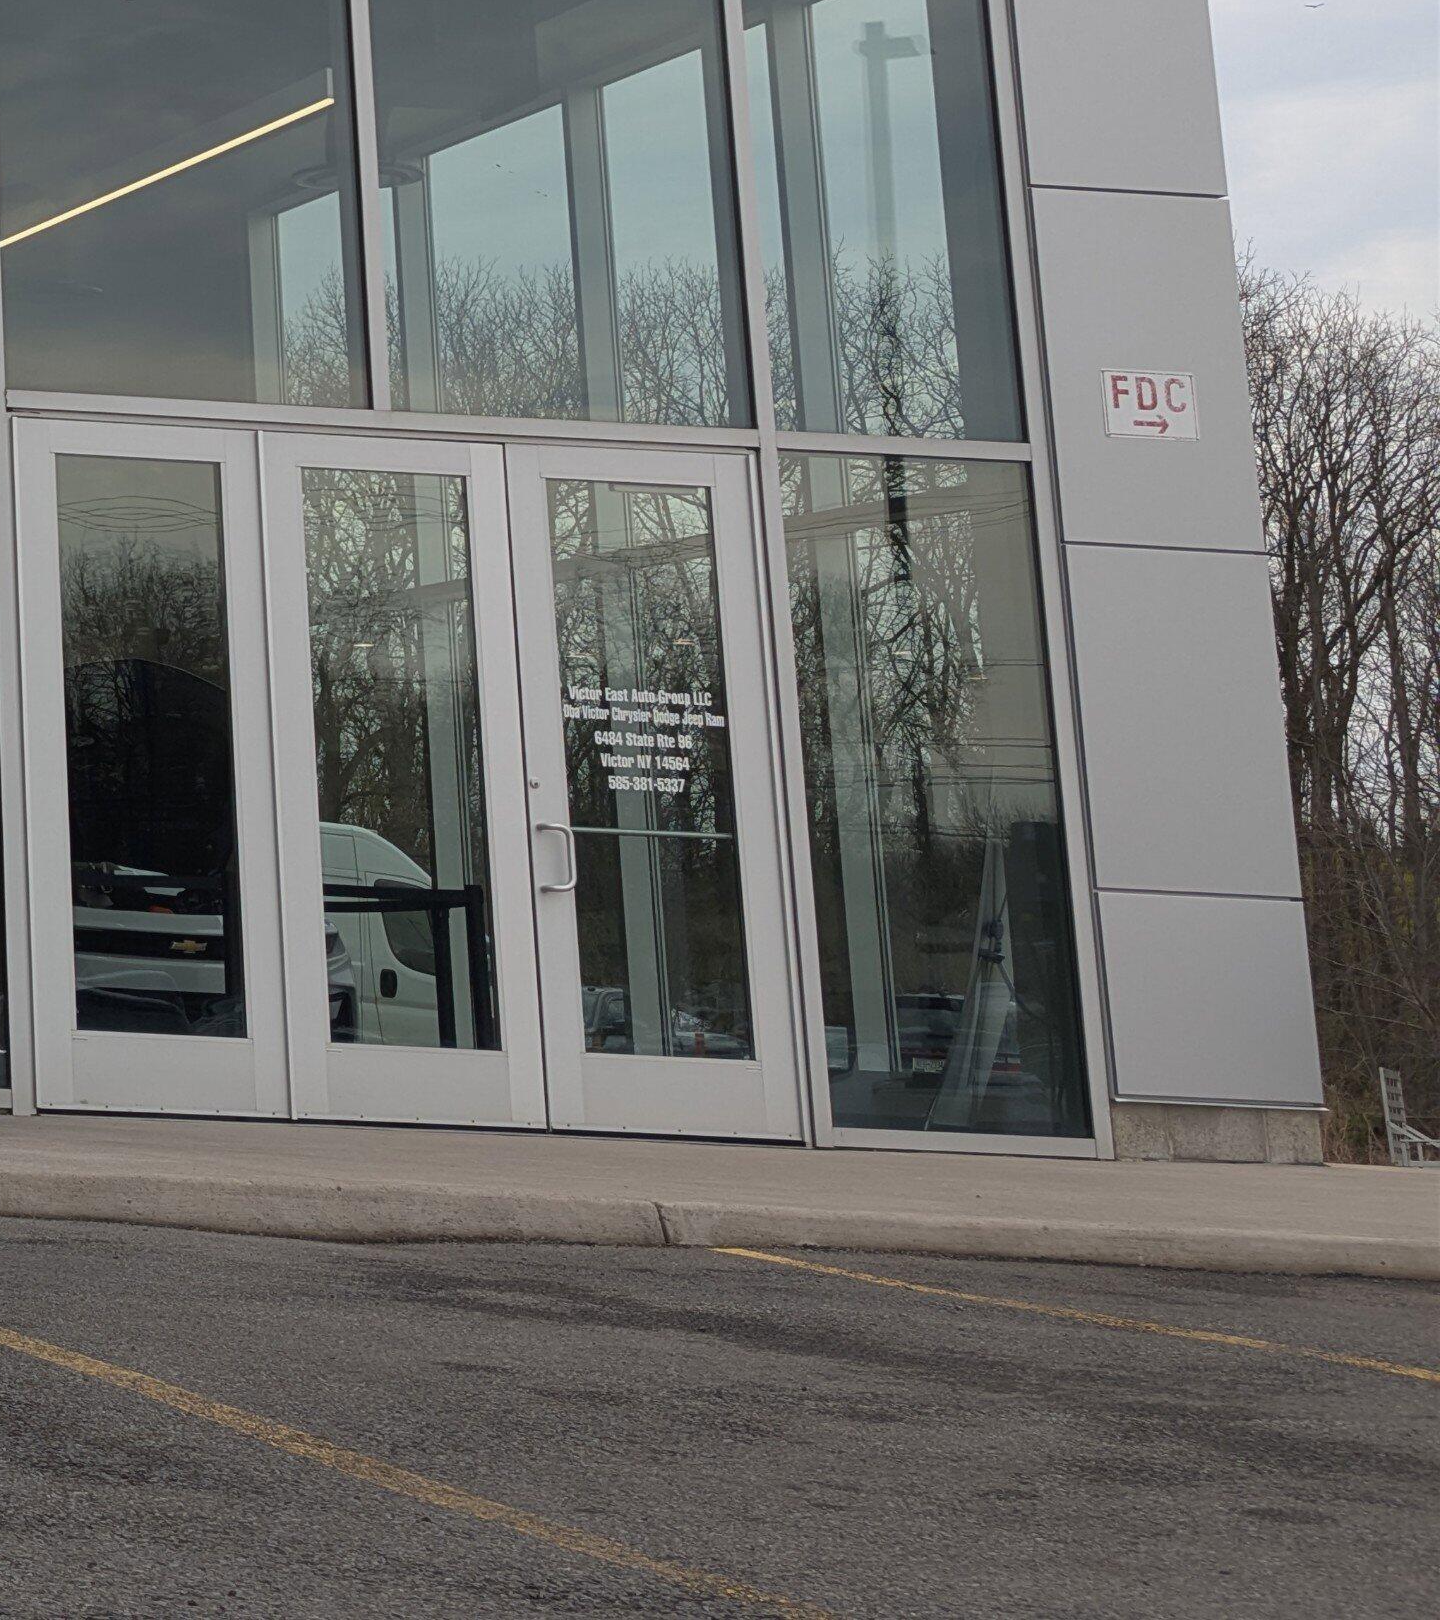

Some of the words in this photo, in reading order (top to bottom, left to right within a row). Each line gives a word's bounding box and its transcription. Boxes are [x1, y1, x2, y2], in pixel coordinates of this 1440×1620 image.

[1110, 374, 1187, 413] FDC
[566, 683, 602, 701] Victor
[605, 687, 629, 702] East
[631, 688, 656, 703] Auto
[657, 689, 691, 708] Group
[693, 691, 713, 706] LLC
[582, 705, 610, 721] Victor
[611, 706, 651, 724] Chrysler
[653, 707, 681, 727] Dodge
[682, 709, 704, 728] Jeep
[705, 711, 726, 727] Ram
[594, 730, 623, 746] 6484
[625, 732, 655, 748] State
[656, 733, 676, 749] Rte
[677, 733, 693, 750] 96
[600, 752, 634, 768] Victor
[637, 754, 652, 769] NY
[654, 755, 691, 771] 14564
[607, 775, 686, 793] 585-381-5337
